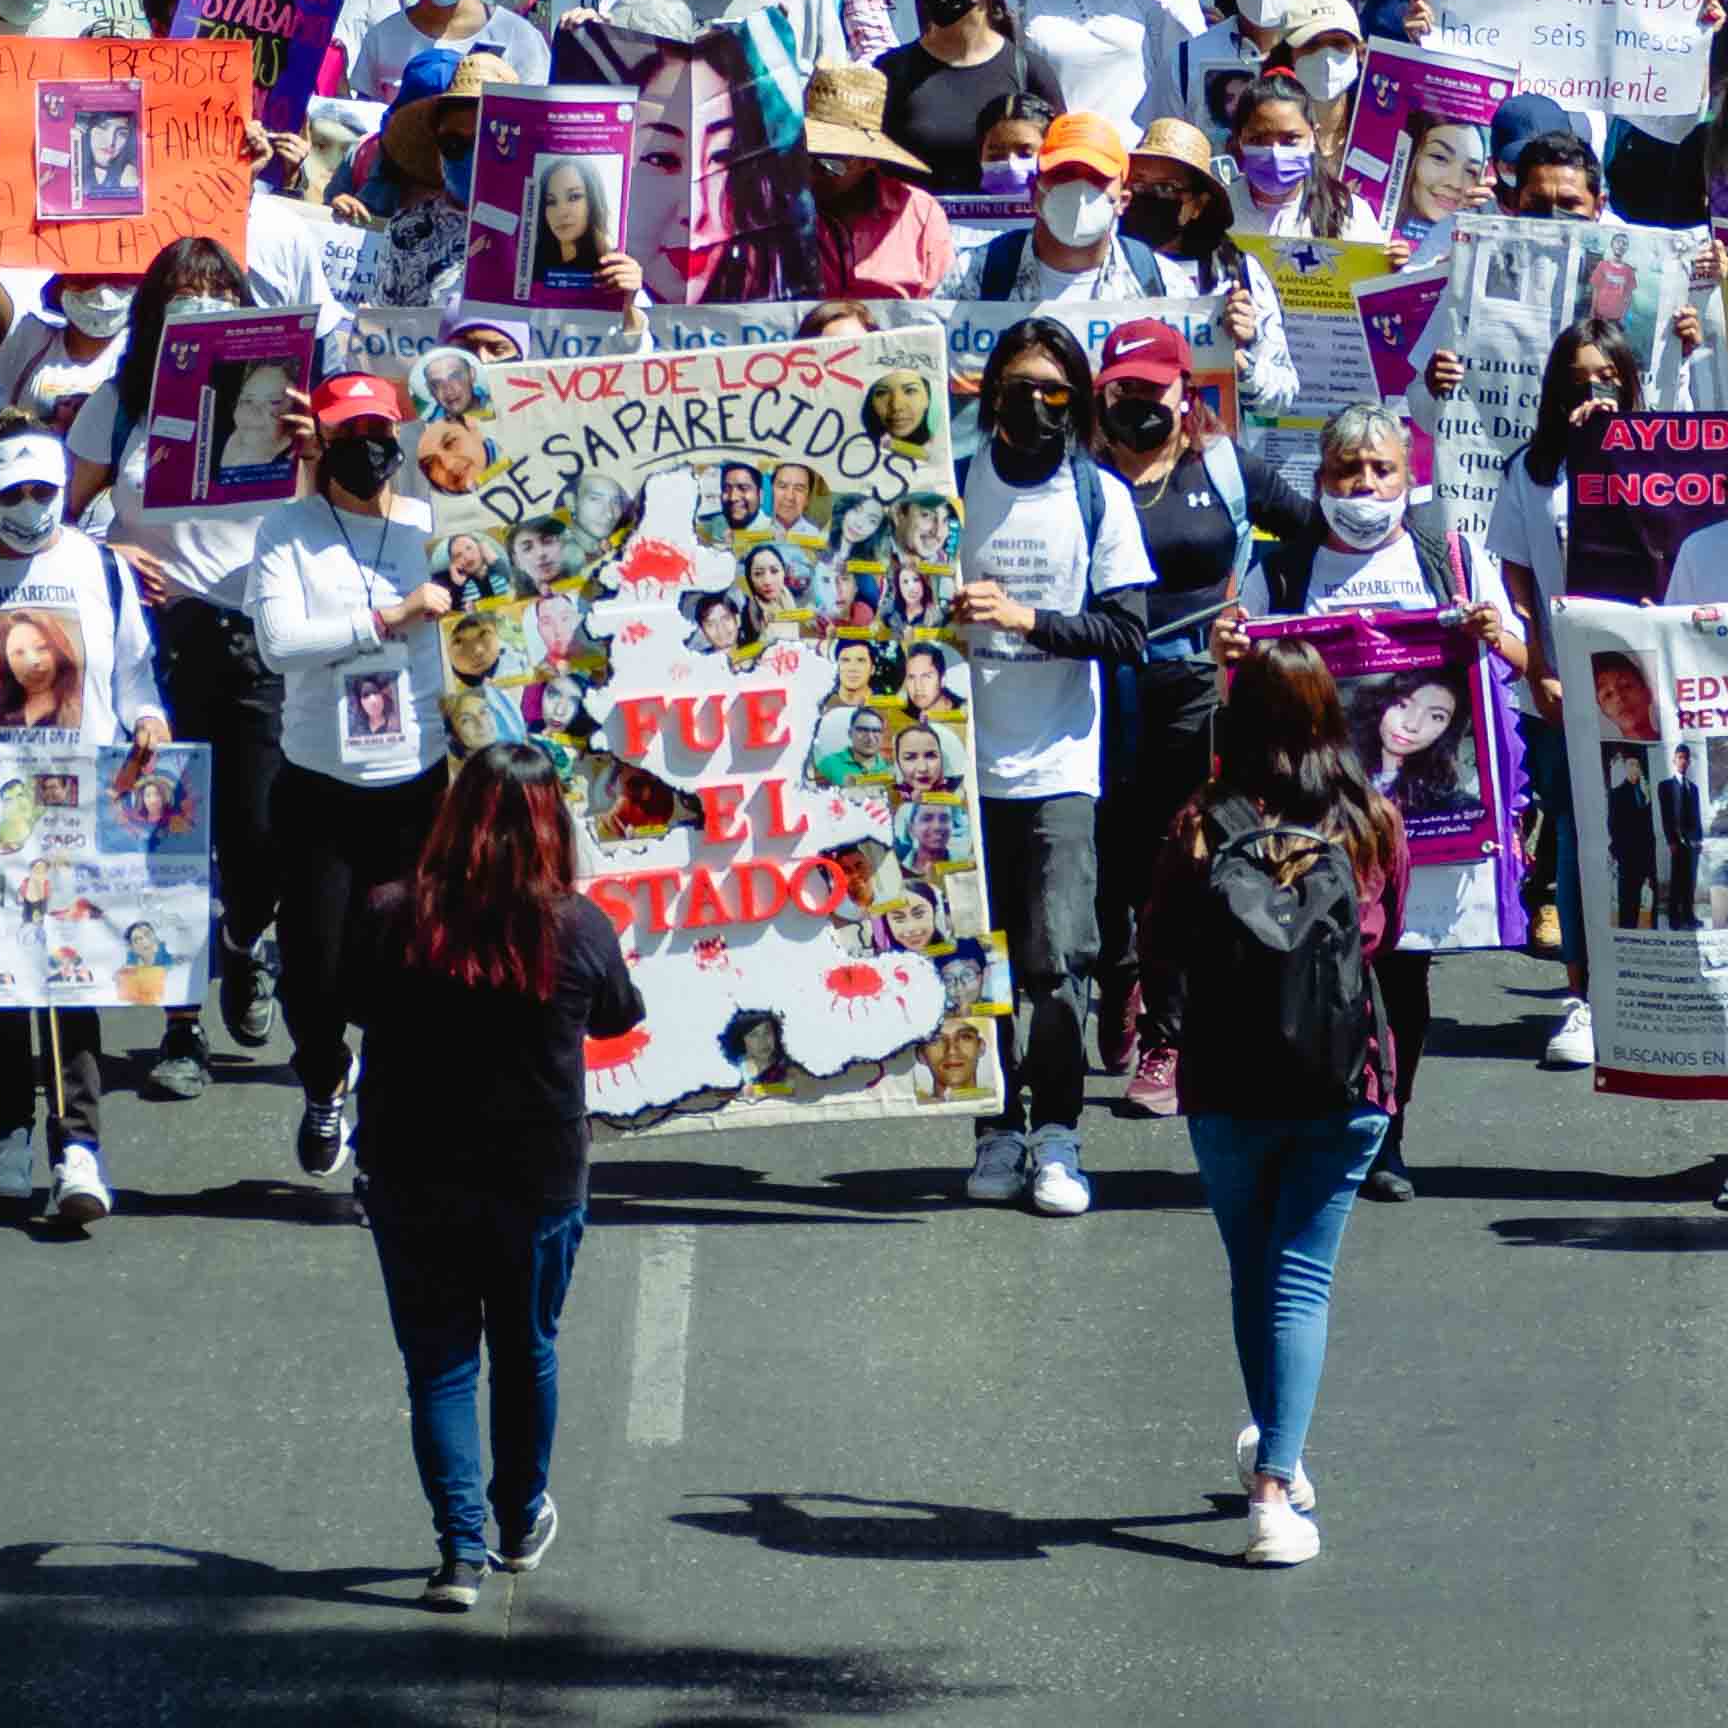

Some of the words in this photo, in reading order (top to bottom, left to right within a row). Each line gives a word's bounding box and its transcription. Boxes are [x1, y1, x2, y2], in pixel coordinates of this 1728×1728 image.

[1440, 11, 1500, 48] hace
[1533, 22, 1586, 48] seis
[96, 44, 242, 89] RESISTE
[547, 363, 626, 401] VOZ
[642, 361, 699, 394] DE
[713, 346, 822, 394] LOS
[1478, 384, 1509, 407] mi
[1437, 418, 1484, 440] que
[481, 386, 916, 527] DESAPARECIDOS
[1459, 451, 1505, 474] que
[617, 687, 793, 759] FUE
[698, 778, 810, 847] EL
[584, 855, 850, 940] STADO
[1613, 1046, 1698, 1067] BUSCANOS
[1702, 1048, 1727, 1066] EN
